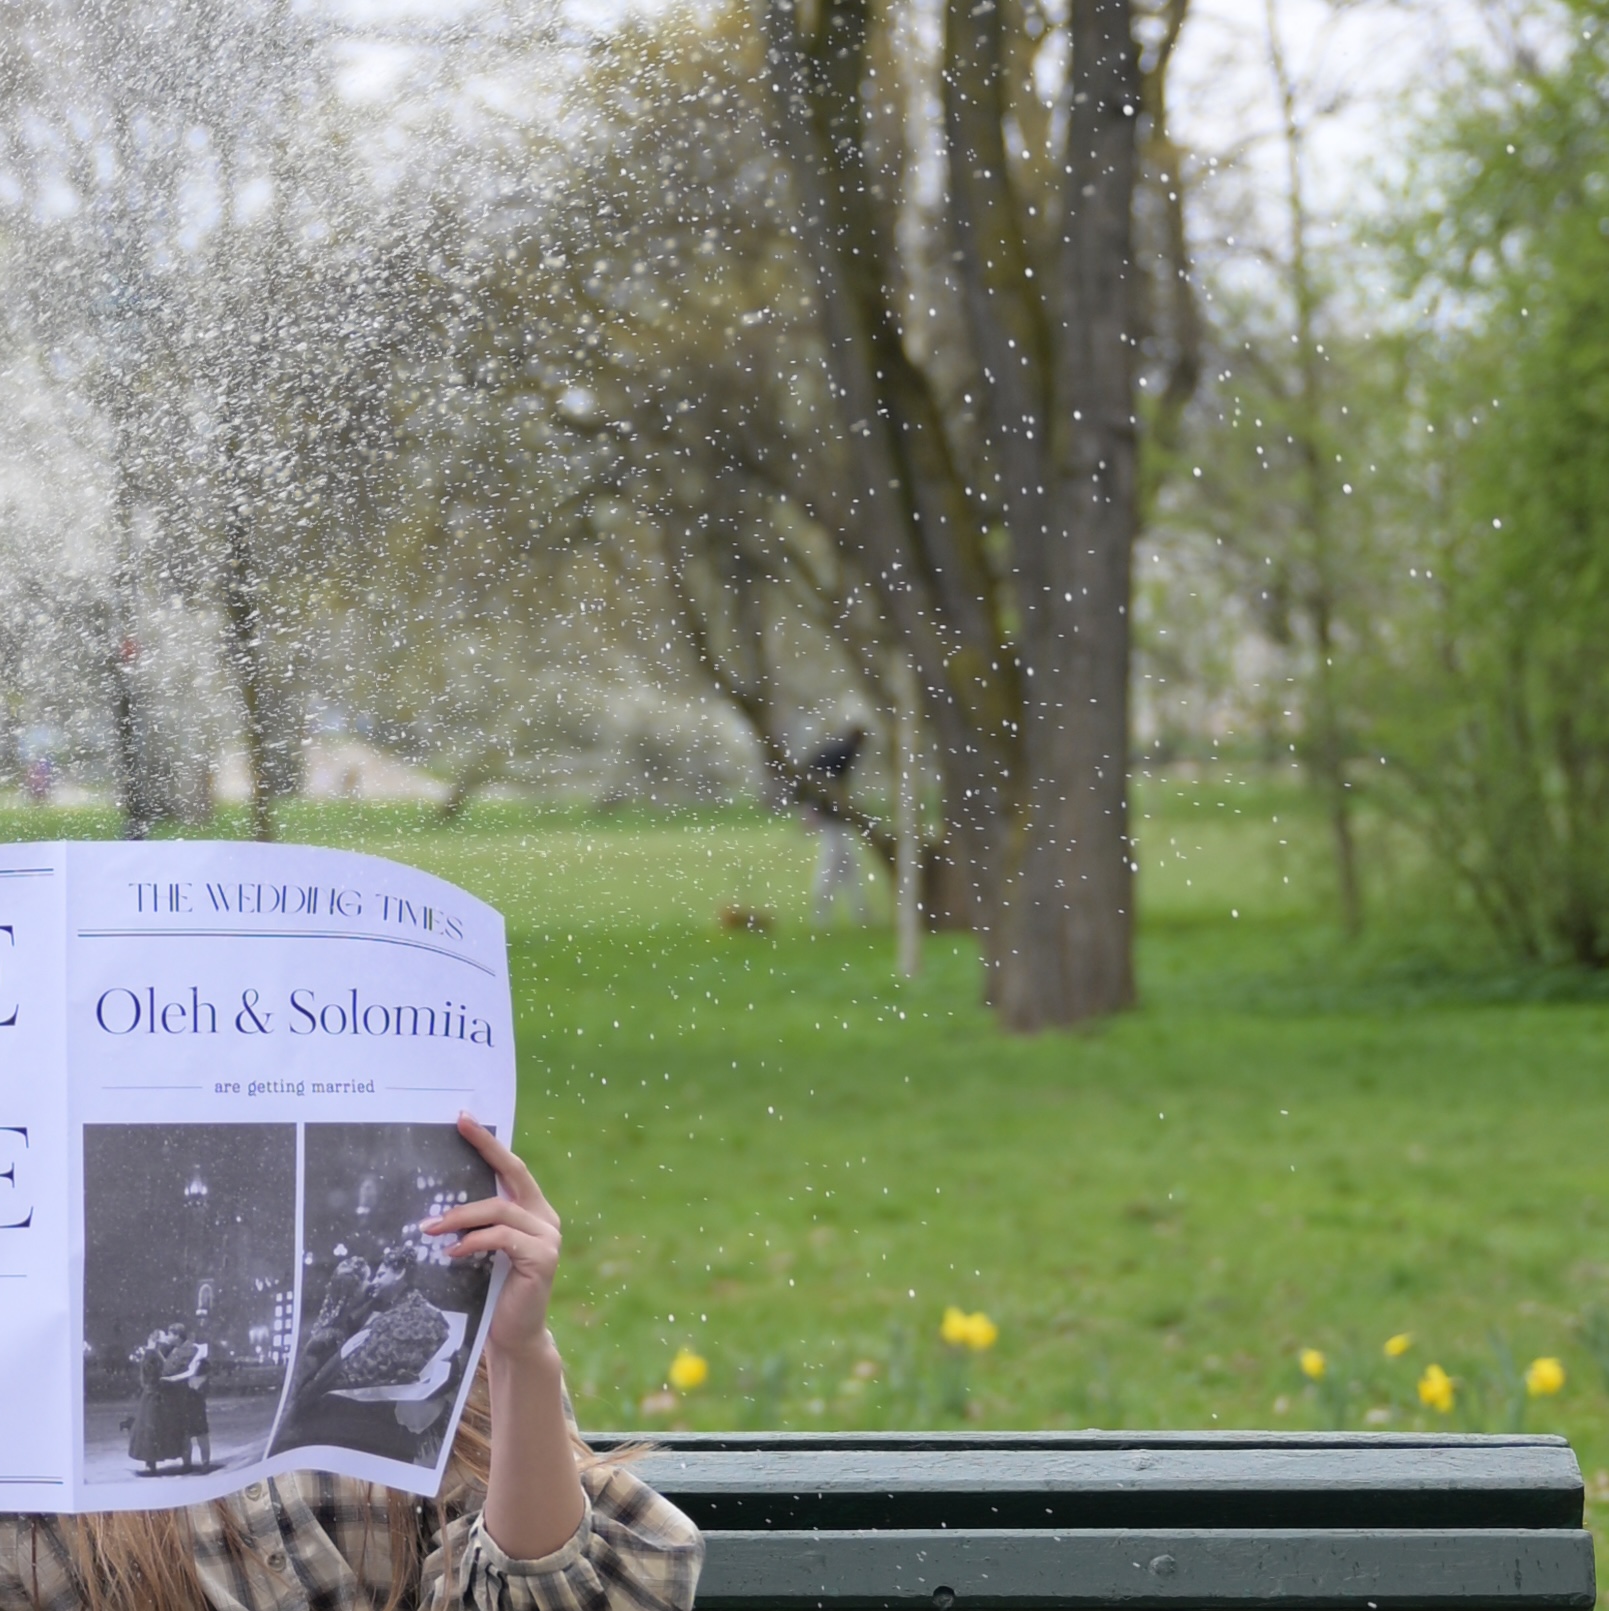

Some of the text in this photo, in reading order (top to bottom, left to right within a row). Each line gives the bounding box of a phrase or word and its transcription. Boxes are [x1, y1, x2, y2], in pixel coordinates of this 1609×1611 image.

[128, 882, 464, 942] THE WEDDING TIMES
[95, 986, 496, 1048] Oleh & Solomiia
[214, 1079, 376, 1097] are getting married
